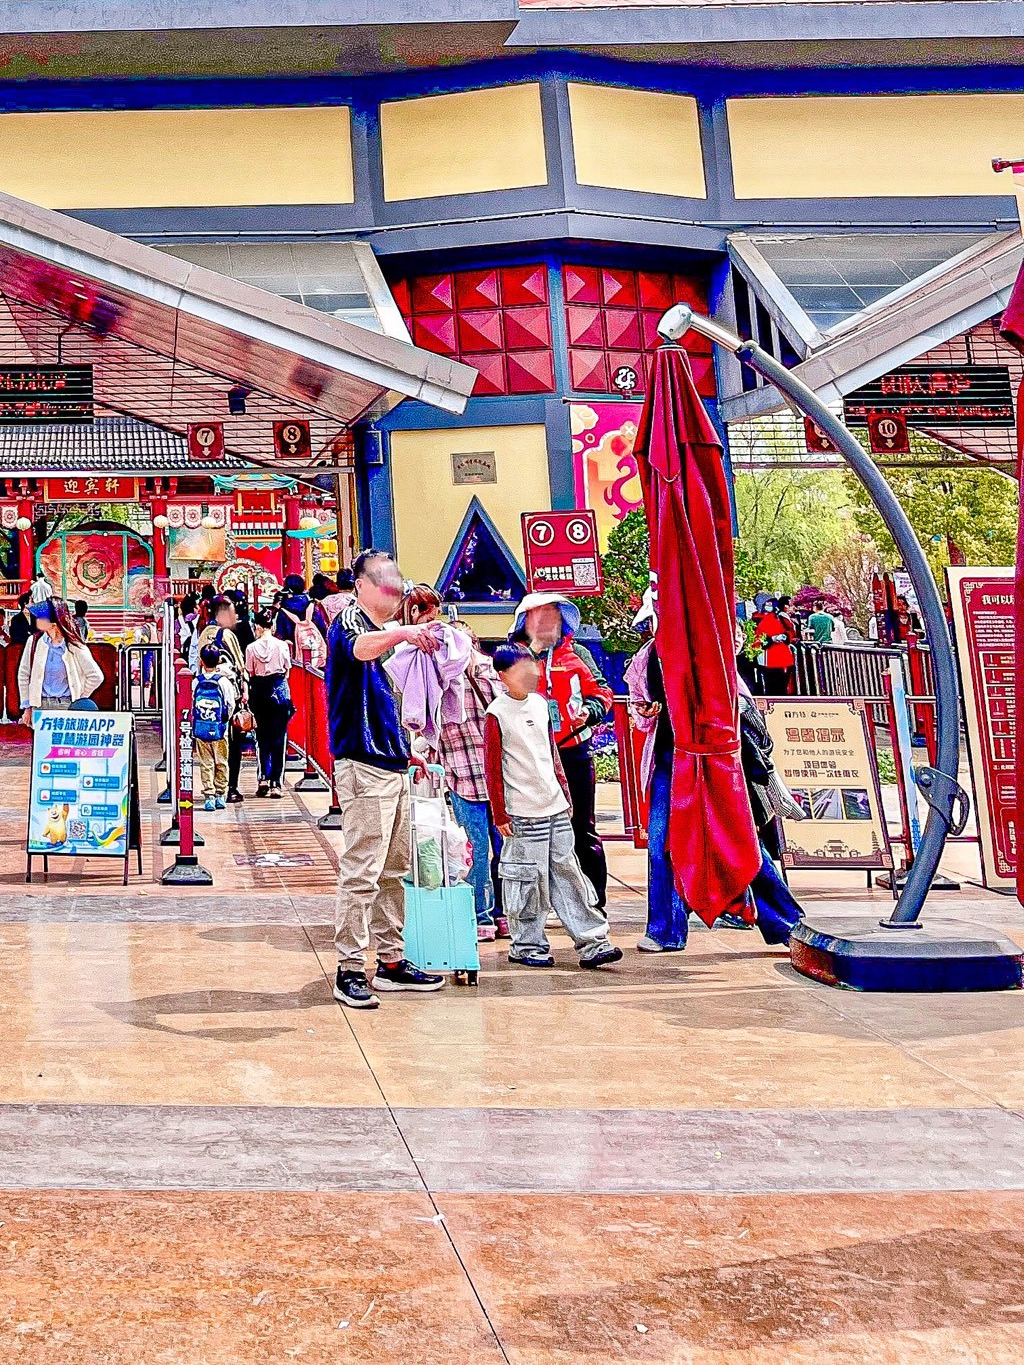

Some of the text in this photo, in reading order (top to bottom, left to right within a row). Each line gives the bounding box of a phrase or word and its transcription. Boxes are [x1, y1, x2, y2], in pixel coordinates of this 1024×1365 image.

[63, 477, 120, 495] 迎宾轩
[39, 717, 116, 732] 方特旅游APP
[51, 731, 125, 747] 智慧游园神器
[785, 727, 846, 743] 温馨提示
[179, 708, 194, 791] 7号检票通道
[783, 748, 855, 756] 为了您和他人的游玩安全
